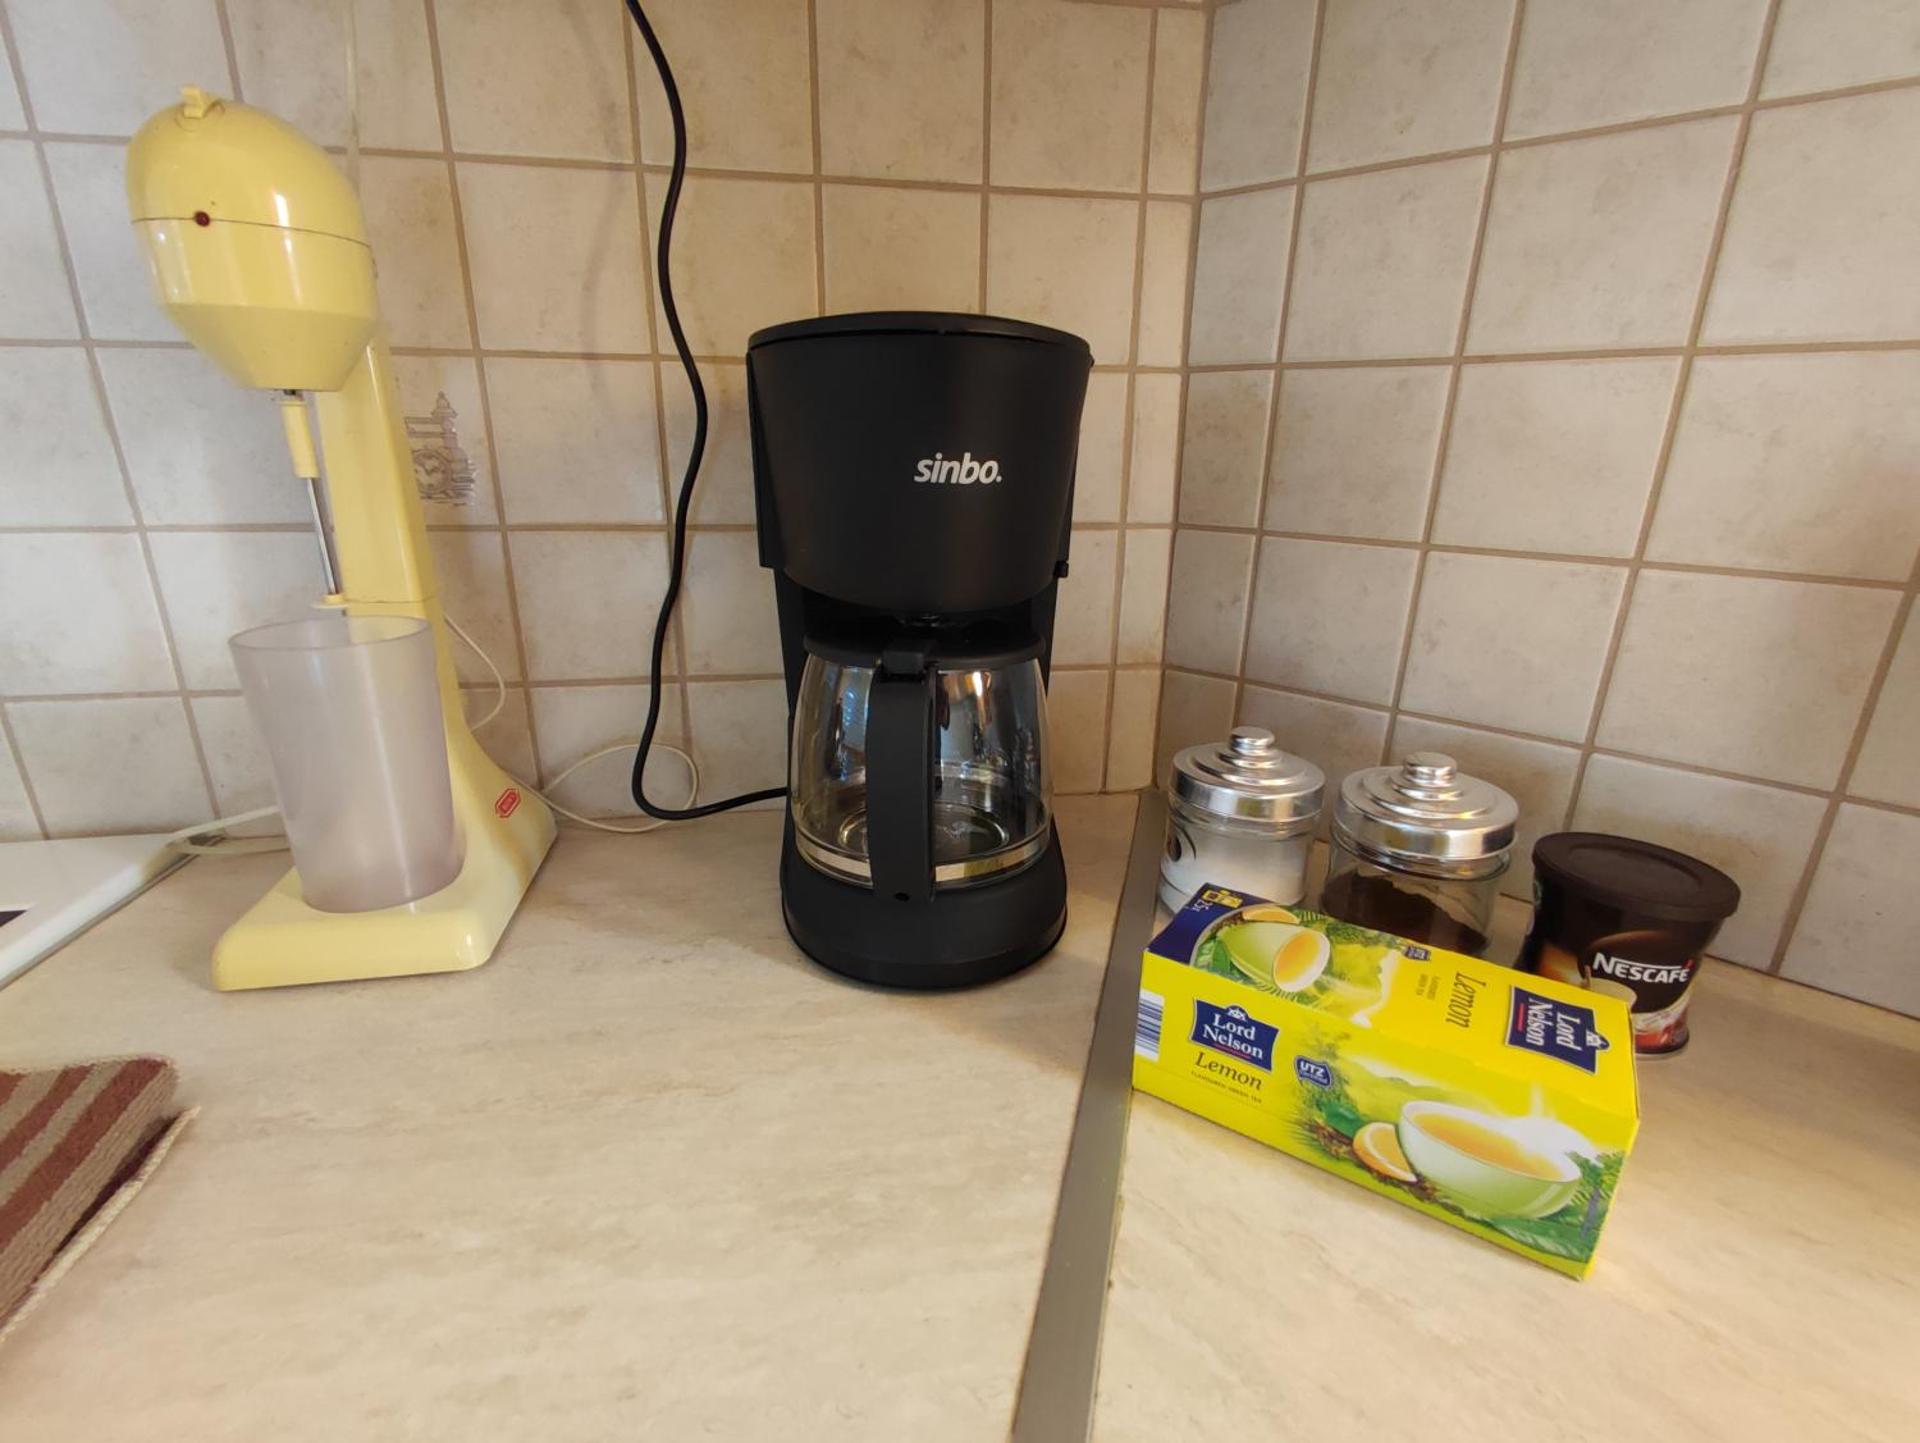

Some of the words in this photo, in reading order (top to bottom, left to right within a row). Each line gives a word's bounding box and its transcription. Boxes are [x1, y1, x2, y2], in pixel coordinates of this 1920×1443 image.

[1445, 971, 1486, 1028] Lemon
[1213, 1013, 1256, 1040] Lord
[1525, 997, 1554, 1046] Nelson
[1556, 1011, 1582, 1051] Lord
[1203, 1024, 1263, 1059] Nelson
[1195, 1052, 1262, 1090] Lemon
[1300, 1061, 1325, 1077] UTZ
